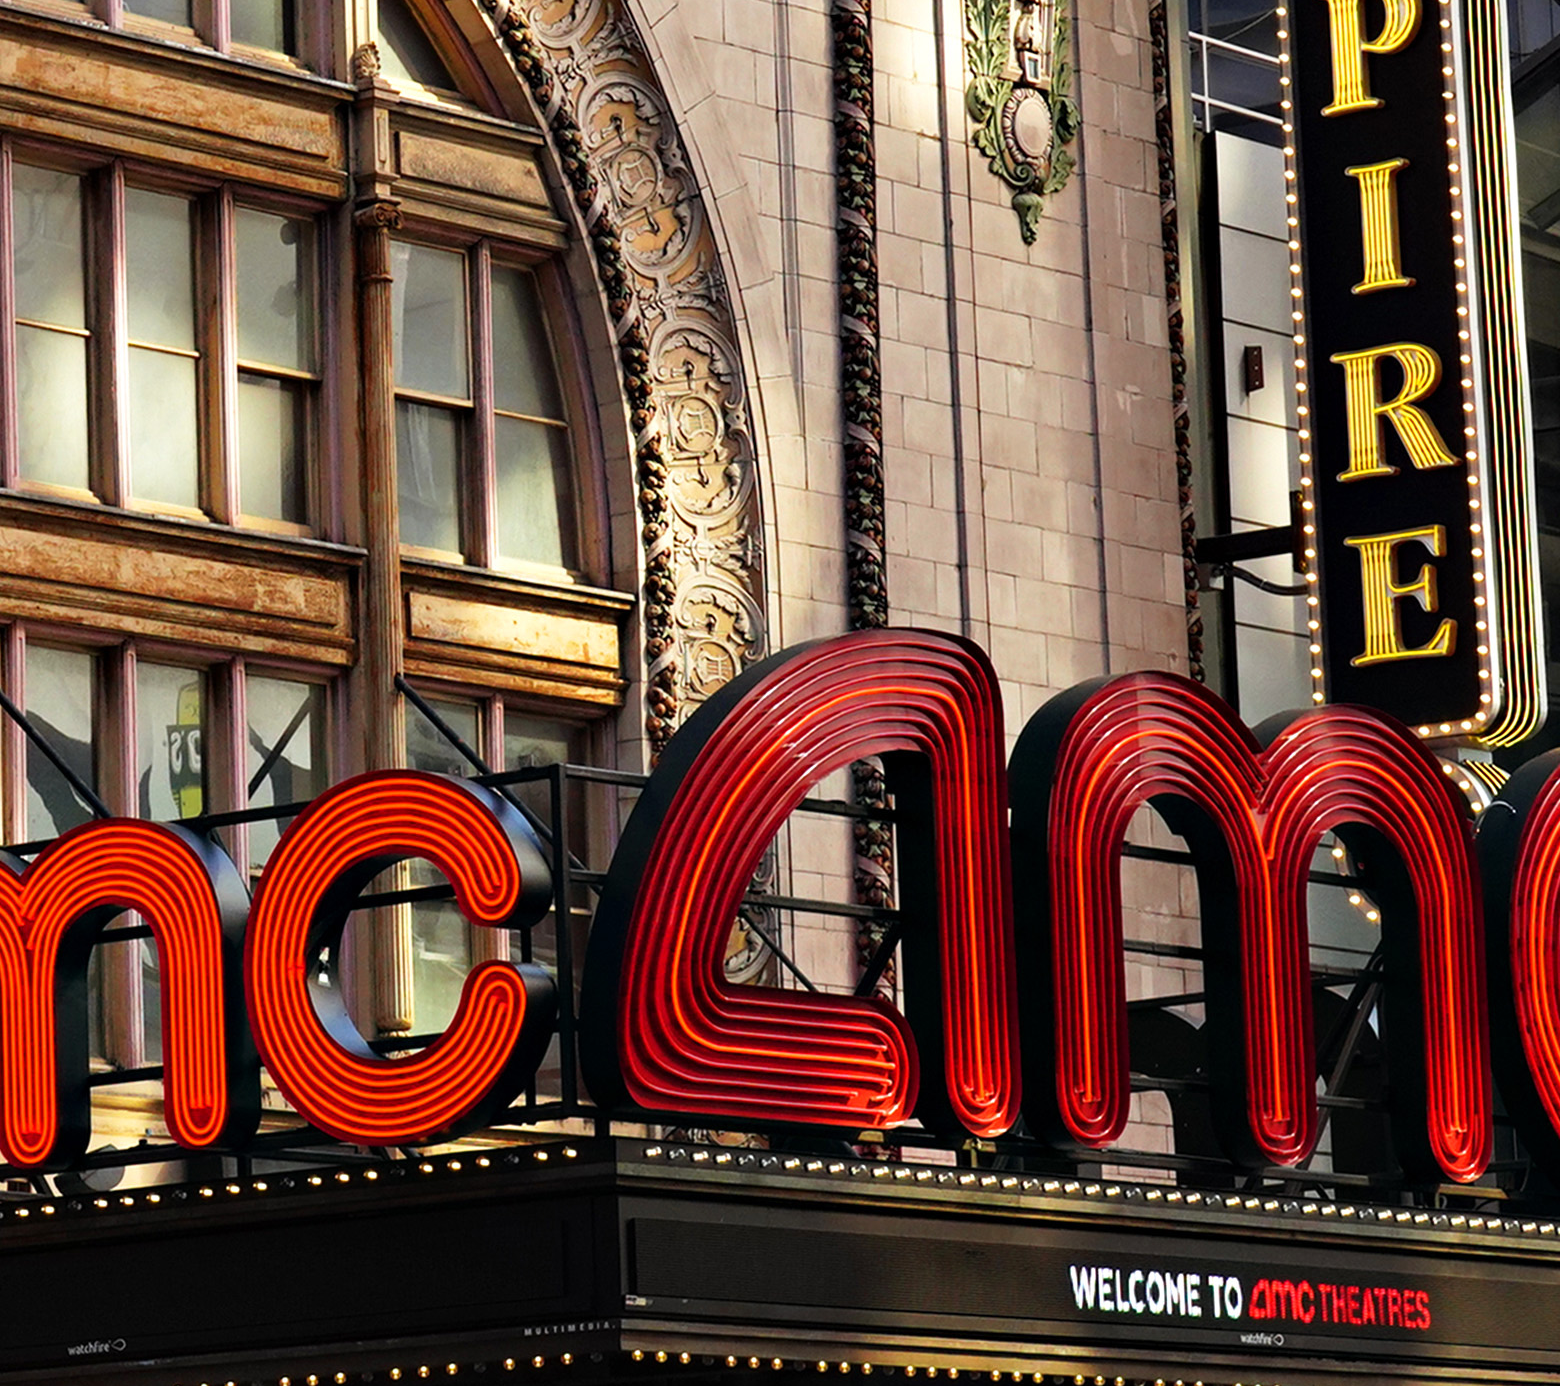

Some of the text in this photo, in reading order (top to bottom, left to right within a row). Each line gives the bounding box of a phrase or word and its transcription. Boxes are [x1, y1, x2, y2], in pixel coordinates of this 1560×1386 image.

[1069, 1265, 1202, 1317] WELCOME
[1208, 1275, 1243, 1319] TO
[1318, 1283, 1431, 1330] THEATRES
[67, 1341, 111, 1356] watchfire
